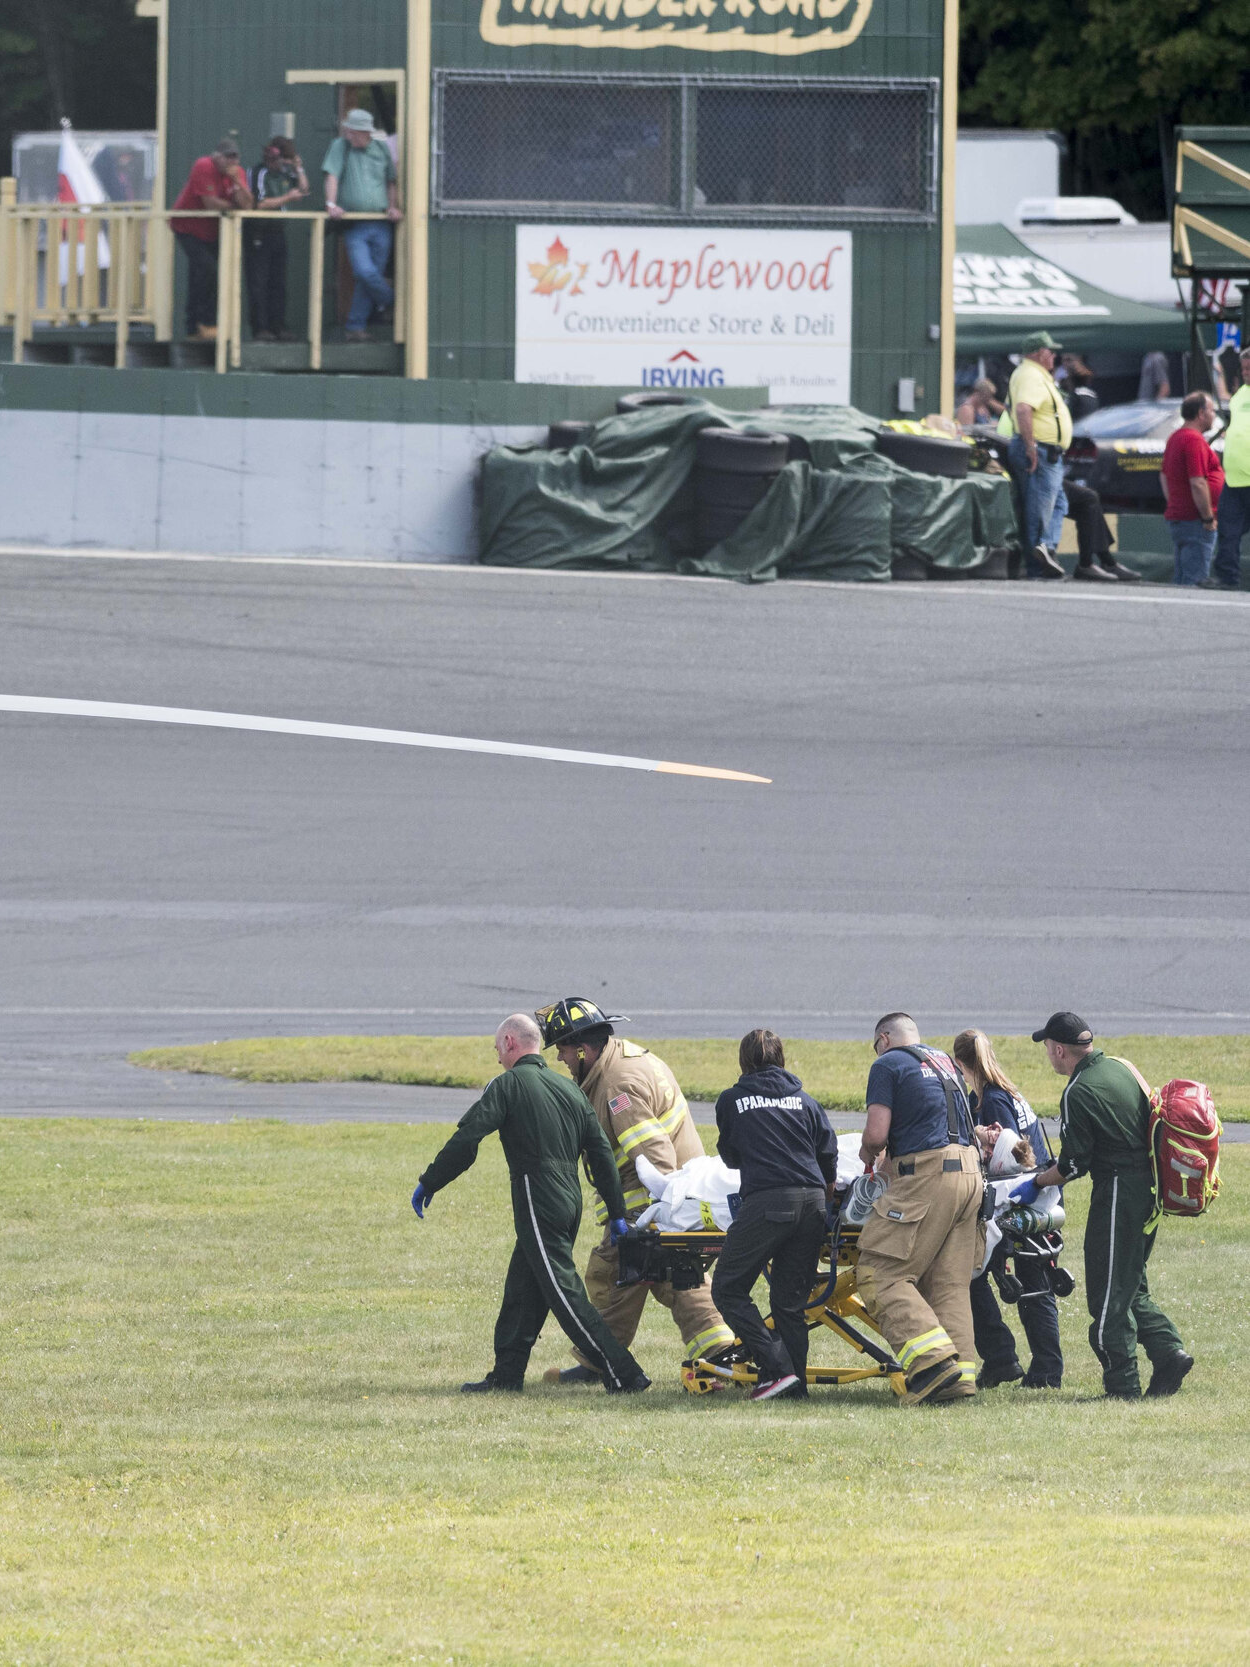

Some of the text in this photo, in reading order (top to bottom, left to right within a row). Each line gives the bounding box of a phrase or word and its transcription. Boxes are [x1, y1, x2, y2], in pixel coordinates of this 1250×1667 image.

[596, 244, 843, 304] Maplewood
[564, 311, 835, 336] Convenience Store & Deli
[642, 368, 725, 388] IRVING
[741, 1095, 803, 1111] PARAMEDIC
